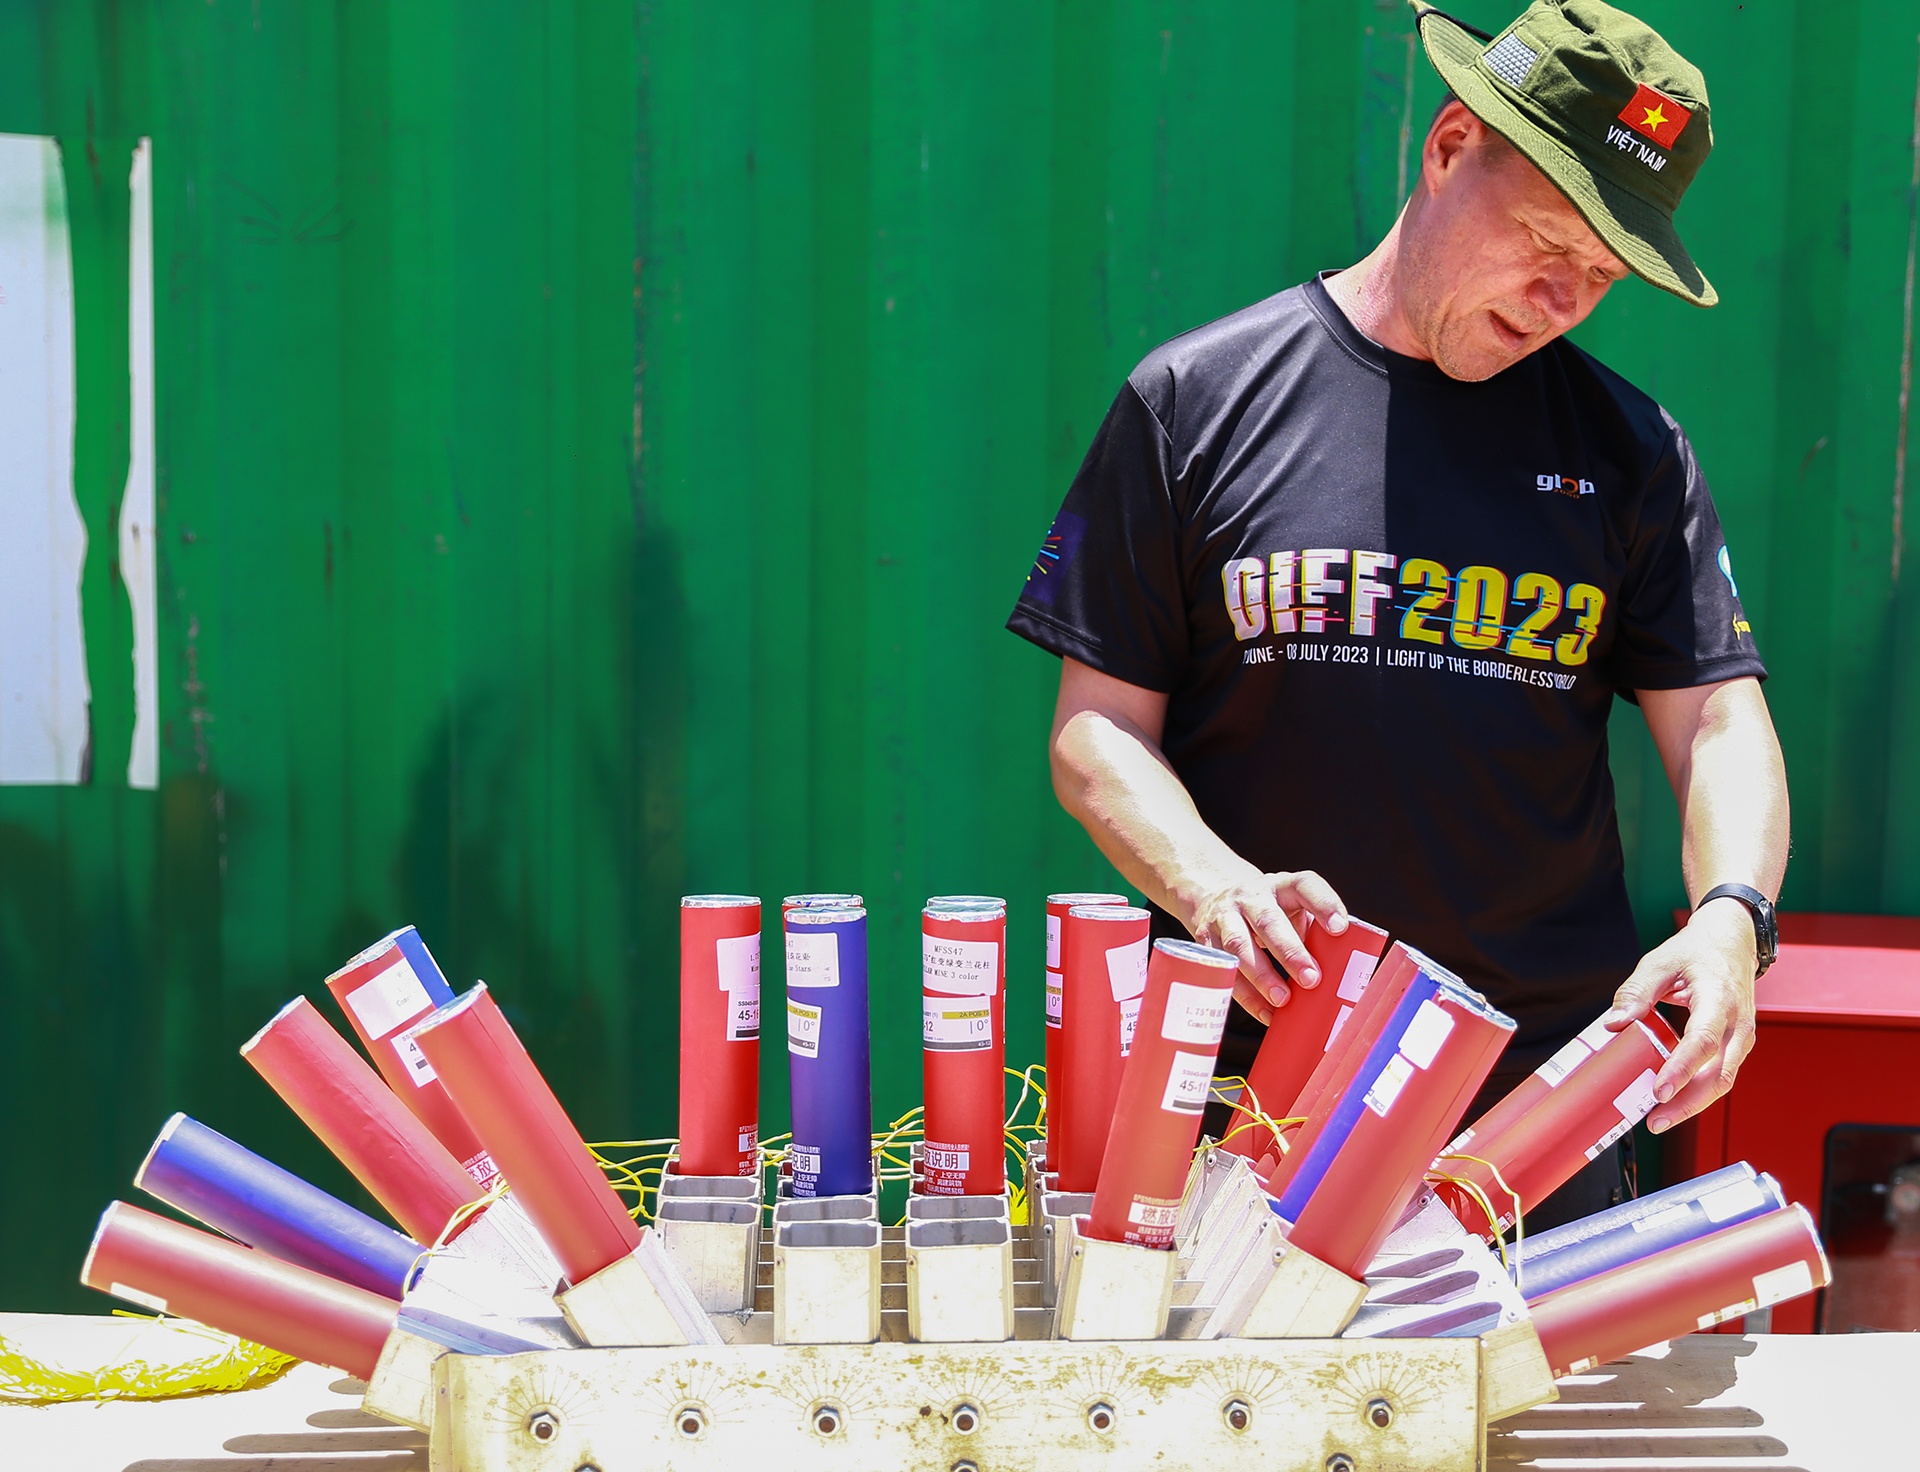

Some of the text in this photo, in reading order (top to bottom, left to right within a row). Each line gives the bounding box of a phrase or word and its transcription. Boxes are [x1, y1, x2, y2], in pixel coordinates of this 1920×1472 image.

[1604, 125, 1668, 172] VIỆT NAM
[1299, 643, 1329, 662] JULY
[1332, 645, 1369, 664] 2023
[1387, 649, 1426, 668] LIGHT
[1429, 654, 1444, 670] UP
[1446, 656, 1470, 675] THE
[1473, 660, 1554, 689] BORDERLESS
[950, 971, 956, 979] 3
[958, 972, 979, 981] color
